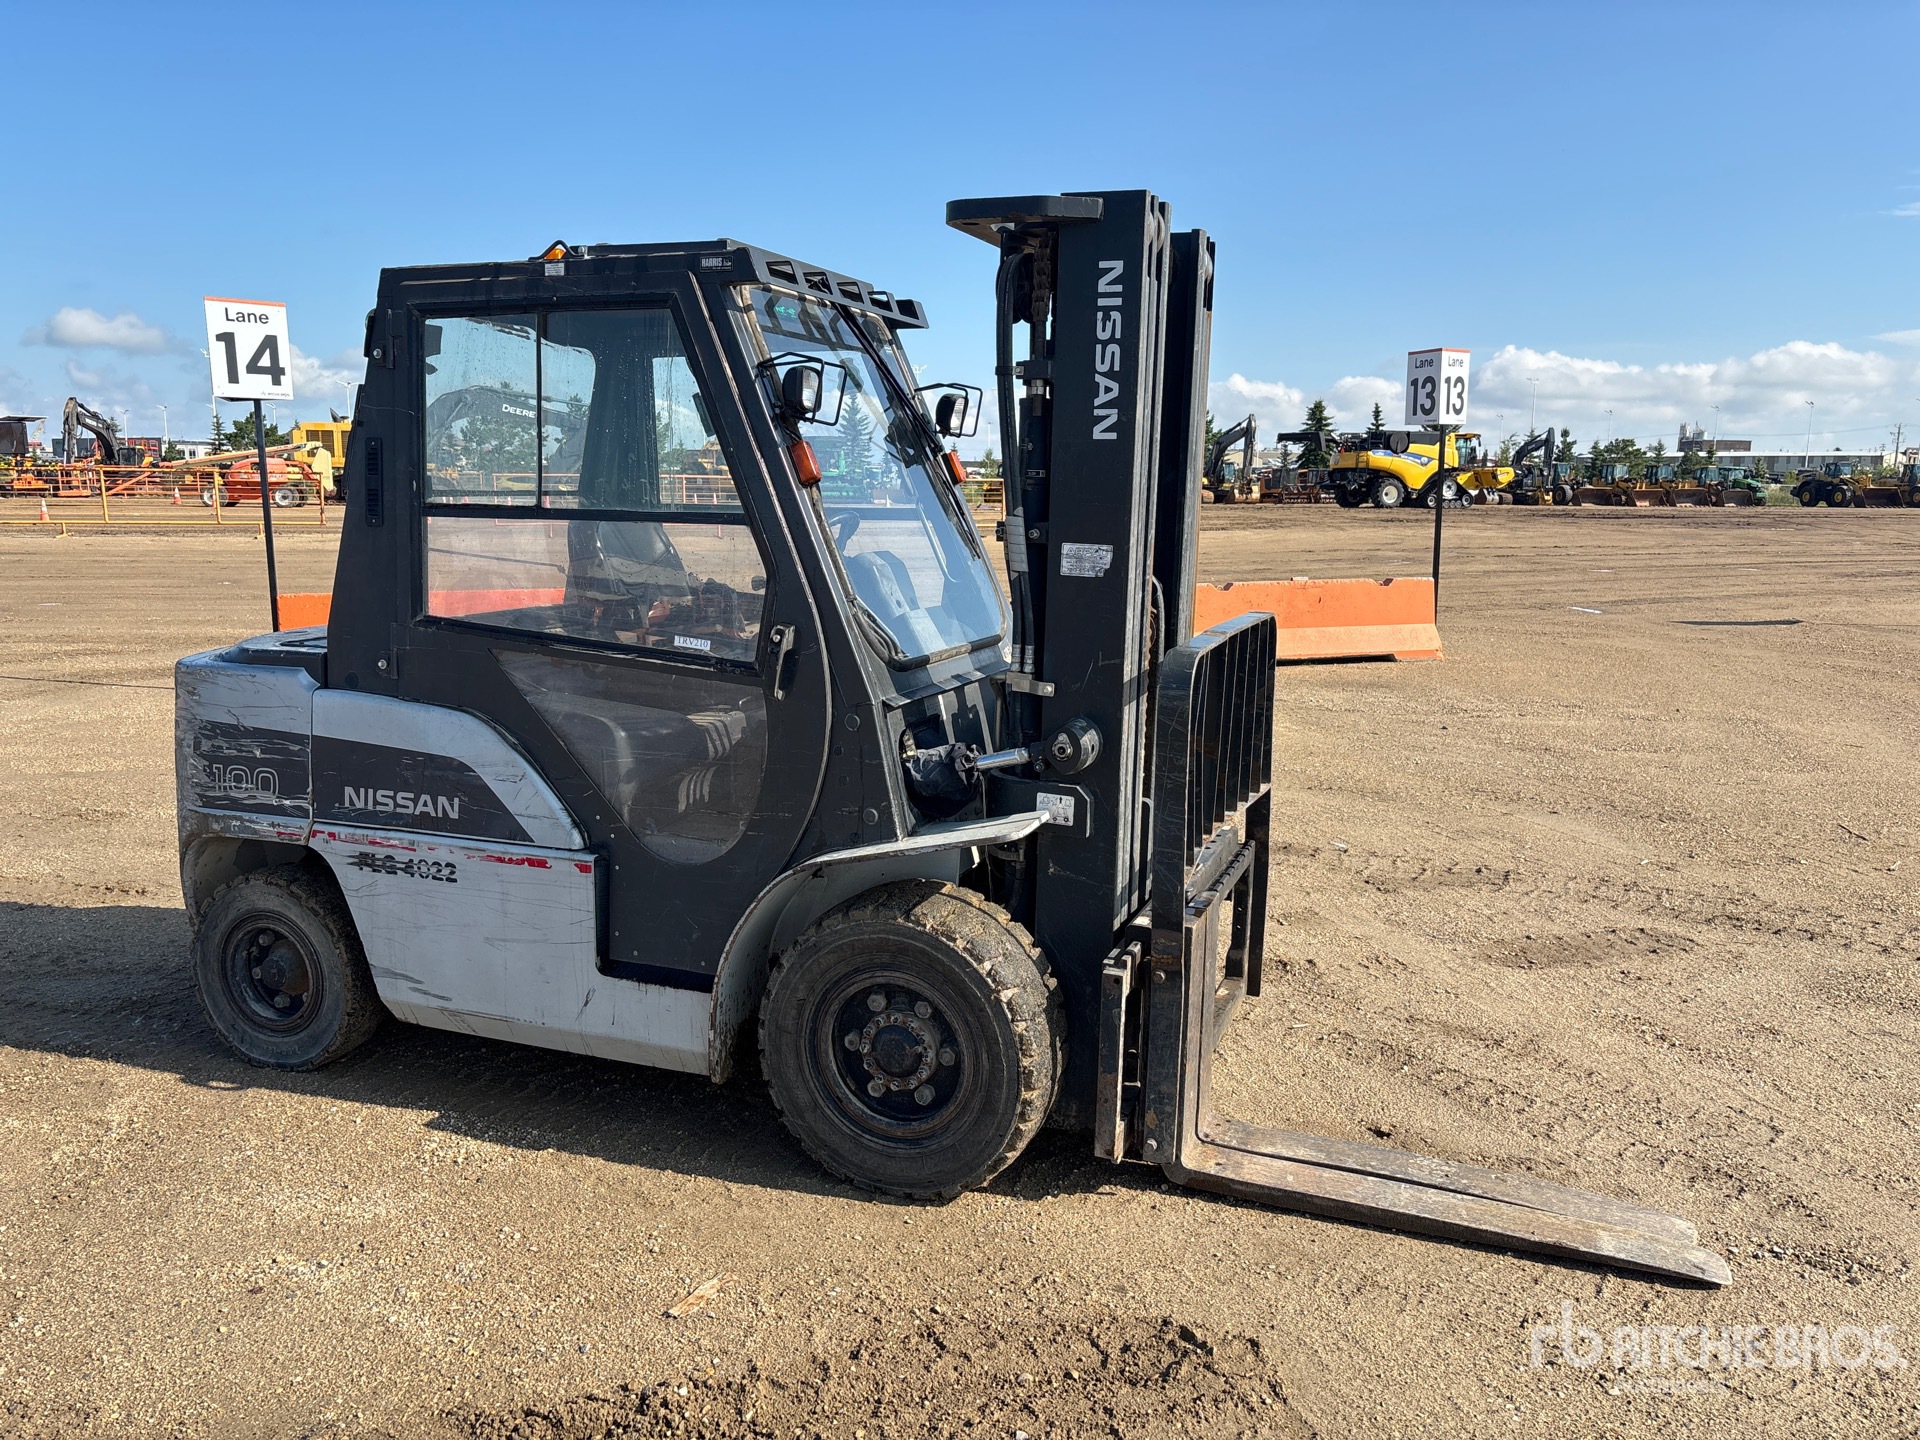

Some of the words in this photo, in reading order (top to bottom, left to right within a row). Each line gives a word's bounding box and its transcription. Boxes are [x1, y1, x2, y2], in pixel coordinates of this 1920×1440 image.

[225, 307, 269, 324] Lane
[215, 331, 285, 386] 14
[1093, 260, 1124, 440] NISSAN
[1415, 358, 1434, 369] Lane
[1448, 355, 1464, 367] Lane
[502, 404, 536, 419] DEERE
[1410, 376, 1437, 416] 13
[1444, 376, 1465, 416] 13
[676, 636, 709, 648] TRV210
[213, 764, 279, 800] 100
[344, 786, 460, 819] NISSAN
